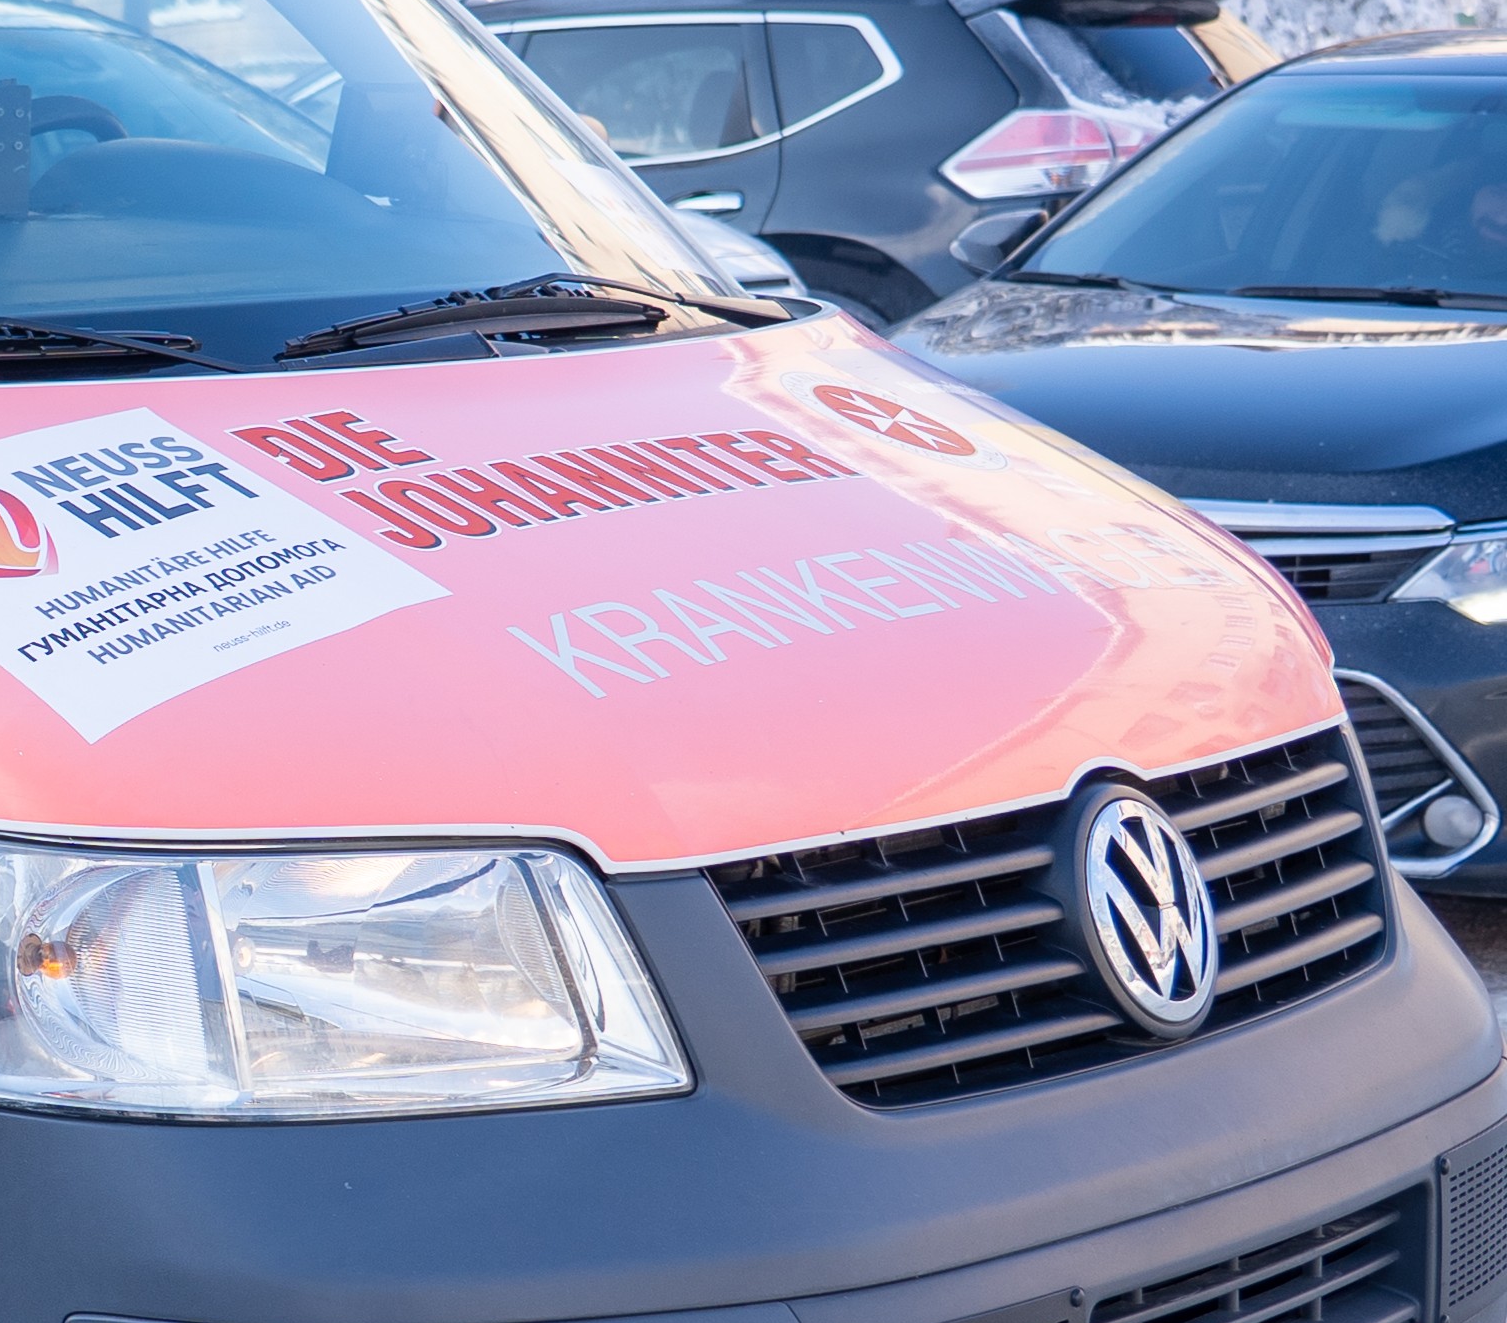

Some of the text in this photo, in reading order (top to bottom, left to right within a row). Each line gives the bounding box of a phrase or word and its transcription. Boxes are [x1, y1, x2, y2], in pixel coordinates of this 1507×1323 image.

[11, 436, 204, 498] NEUSS
[223, 408, 443, 484] DIE
[57, 462, 260, 539] HILFT
[334, 428, 870, 551] JOHANNITER
[17, 538, 346, 662] ГУМАНІТАРНА ДОПОМОГА
[35, 529, 277, 620] HUMANITÄRE HILFE
[86, 565, 337, 664] HUMANITARIAN AID
[213, 619, 292, 652] neuss-hilft.de
